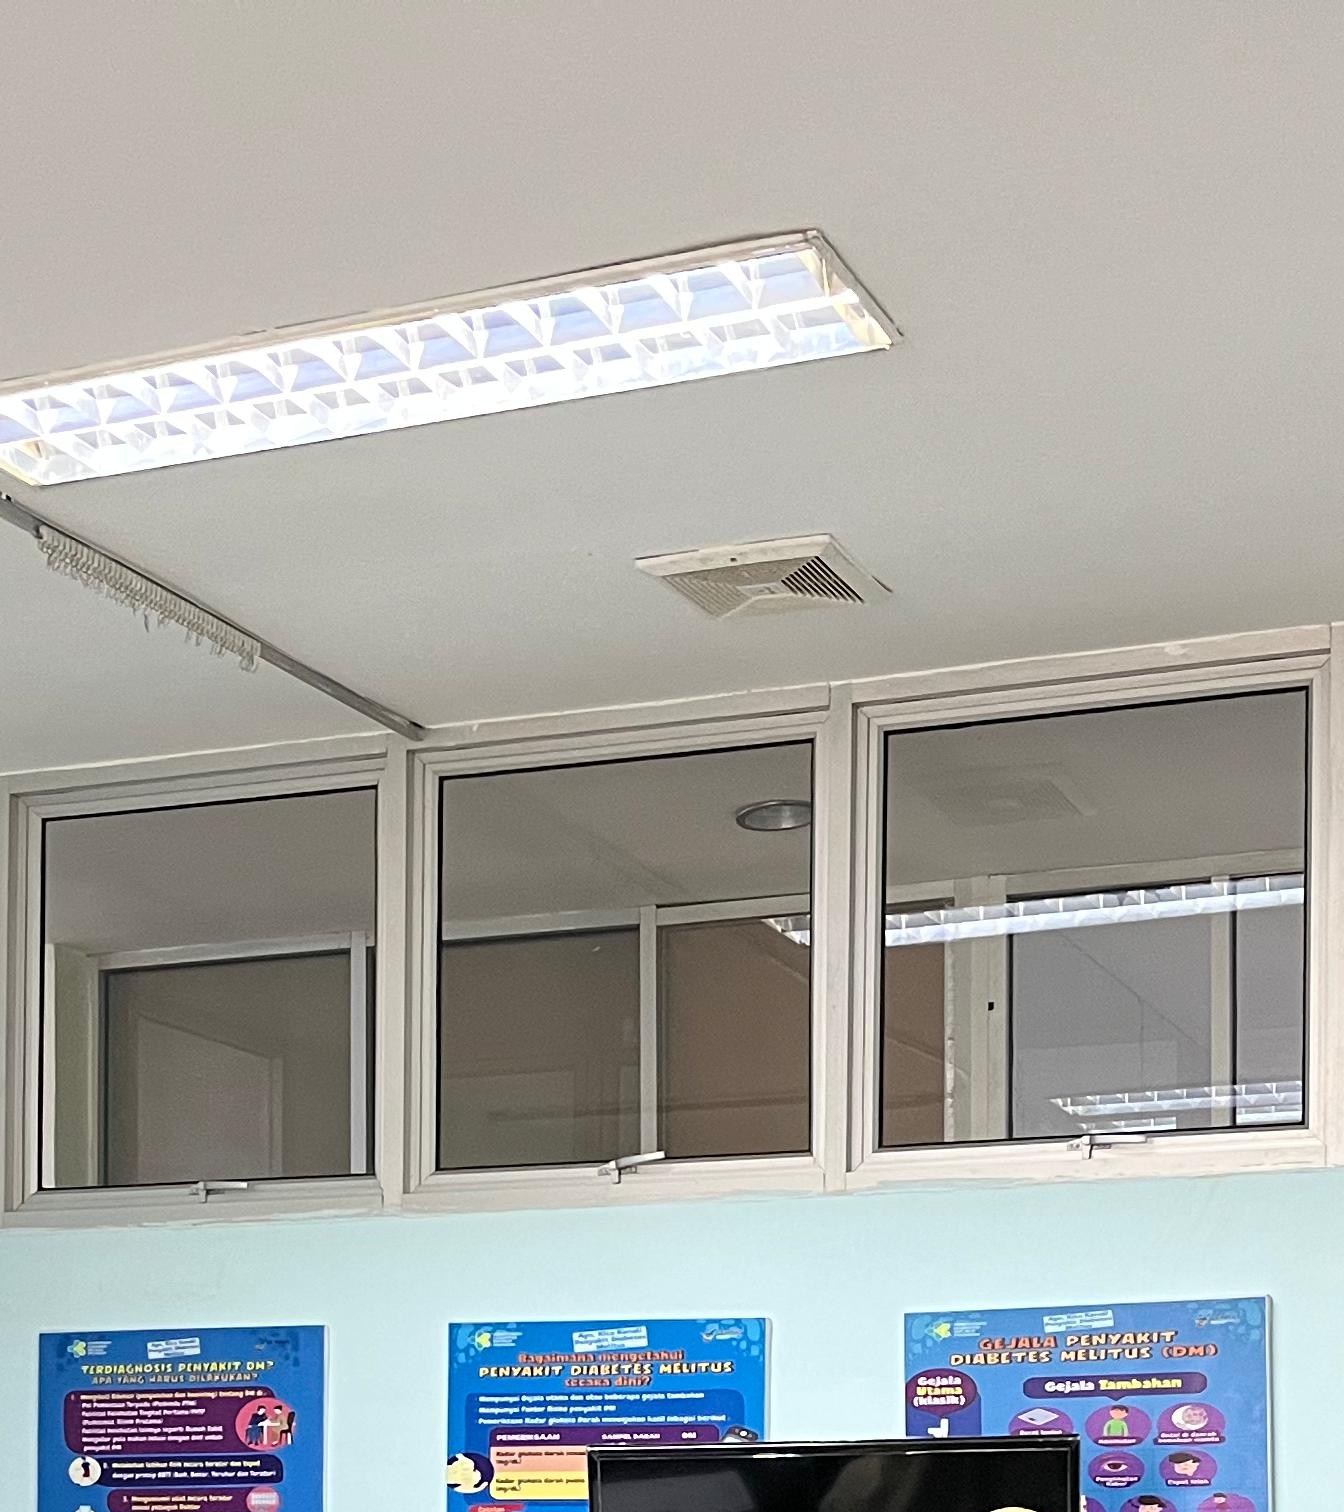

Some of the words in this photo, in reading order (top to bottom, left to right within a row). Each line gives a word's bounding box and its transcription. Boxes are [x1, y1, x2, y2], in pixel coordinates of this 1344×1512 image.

[979, 1336, 1057, 1350] GEJALA
[1066, 1331, 1177, 1347] PENYAKIT
[519, 1353, 594, 1363] Bagaimana
[599, 1350, 683, 1361] mengetahui
[950, 1351, 1052, 1366] DIABETES
[1060, 1347, 1152, 1362] MELITUS
[1162, 1344, 1217, 1358] (DM)
[81, 1363, 172, 1374] TERDIAGNOSIS
[178, 1362, 242, 1372] PENYAKIT
[246, 1360, 274, 1370] DM?
[479, 1366, 563, 1377] PENYAKIT
[571, 1363, 652, 1376] DIABETES
[659, 1362, 733, 1373] MELITUS
[917, 1376, 962, 1387] Gejala
[1044, 1380, 1095, 1393] Gejala
[1098, 1378, 1182, 1390] Tambahan
[916, 1386, 962, 1395] Utama
